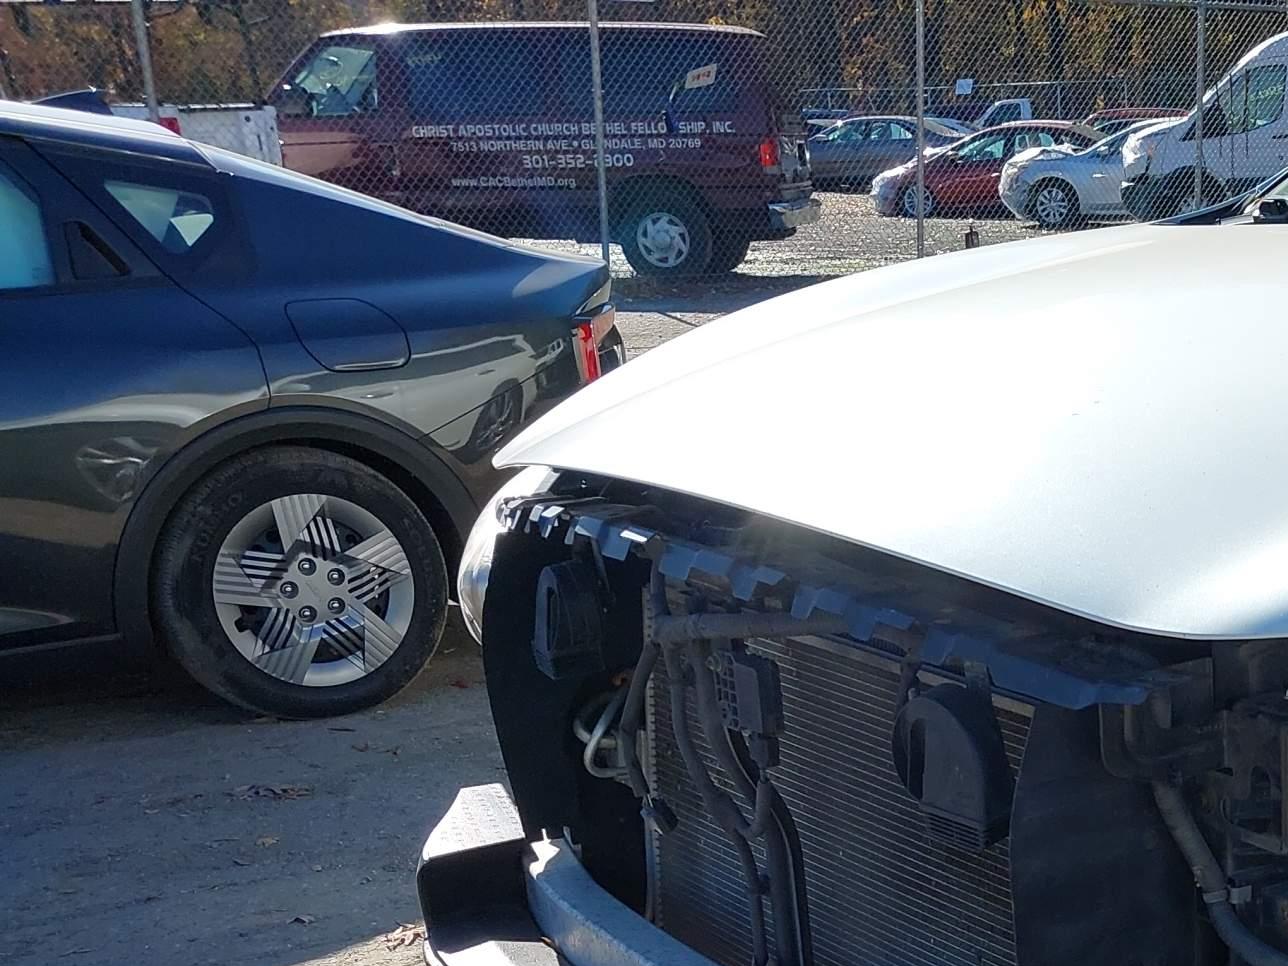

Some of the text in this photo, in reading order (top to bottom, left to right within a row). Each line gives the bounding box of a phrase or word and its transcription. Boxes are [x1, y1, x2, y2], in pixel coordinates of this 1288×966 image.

[412, 125, 454, 138] CHRIST
[458, 124, 528, 137] APOSTOLIC
[530, 123, 578, 136] CHURCH
[581, 122, 628, 135] BEHEL
[712, 121, 736, 133] INC.
[450, 142, 477, 152] 7513
[479, 140, 544, 151] NORTHERN
[581, 138, 646, 150] GLNDALE,
[647, 138, 667, 149] MD
[669, 138, 701, 149] 20769
